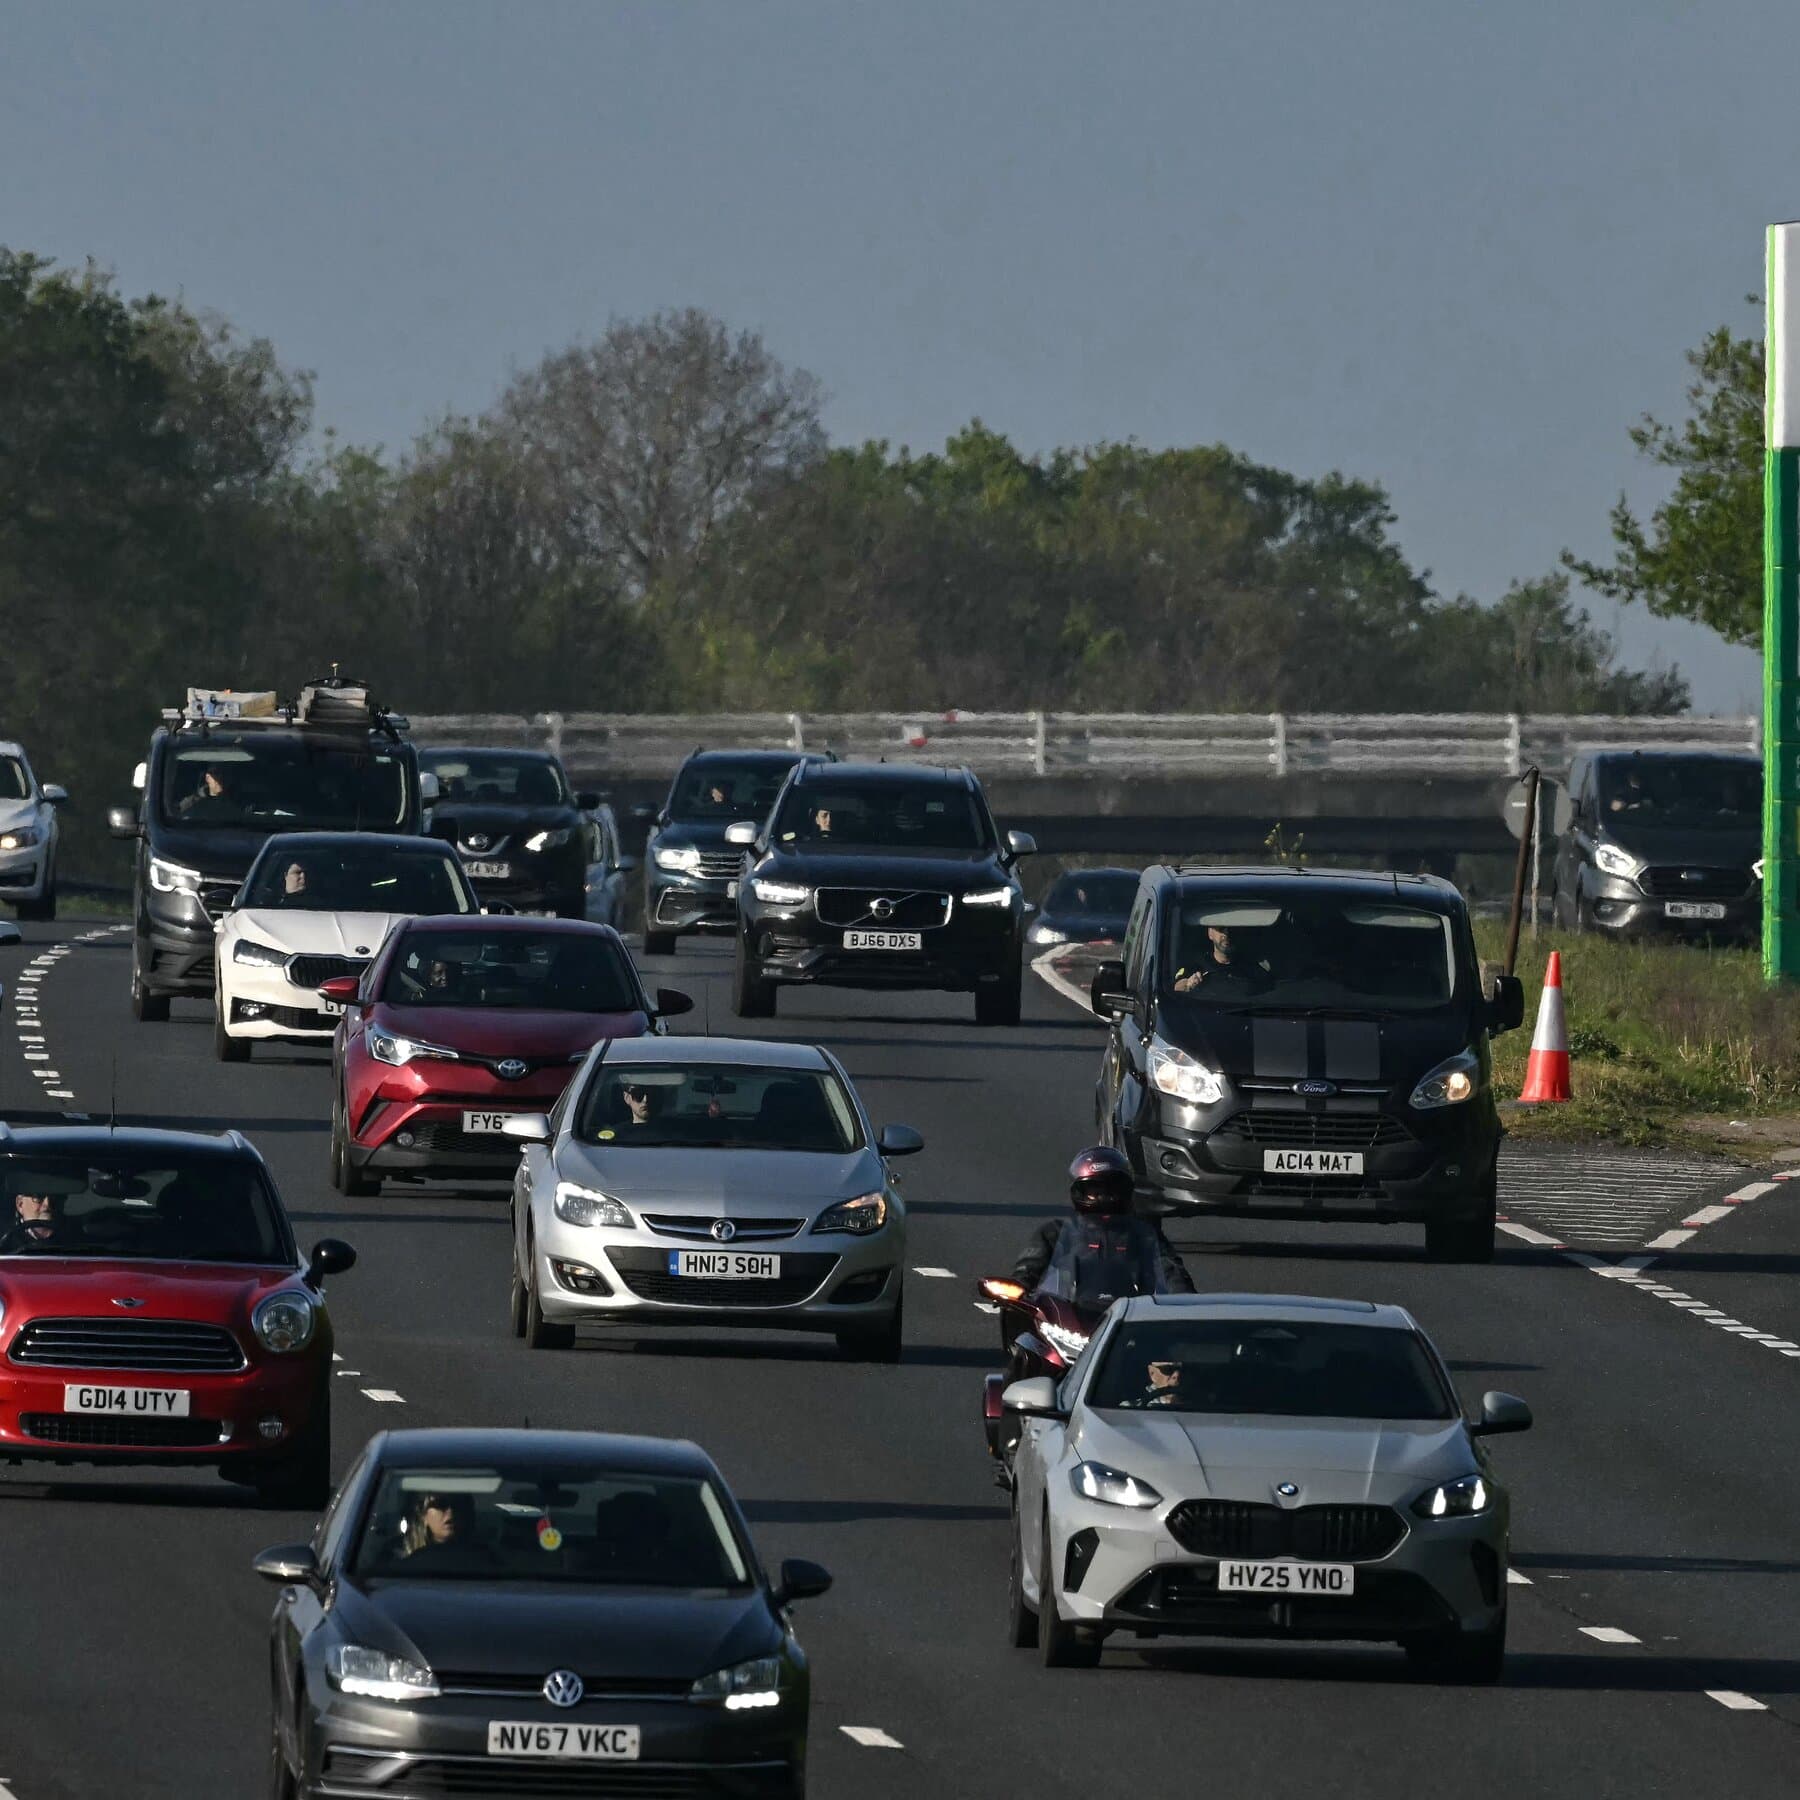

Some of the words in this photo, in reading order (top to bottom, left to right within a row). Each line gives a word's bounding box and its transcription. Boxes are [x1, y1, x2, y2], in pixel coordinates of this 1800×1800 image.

[851, 933, 885, 947] BJ66
[1275, 1153, 1314, 1171] AC14
[1320, 1154, 1353, 1172] MAT
[686, 1254, 729, 1273] HN13
[735, 1256, 773, 1275] SOH
[79, 1388, 127, 1410] GD14
[134, 1390, 177, 1411] UTY
[1229, 1565, 1290, 1588] HV25
[1299, 1567, 1343, 1590] YNO
[500, 1726, 569, 1751] NV67
[577, 1729, 628, 1753] VKC
